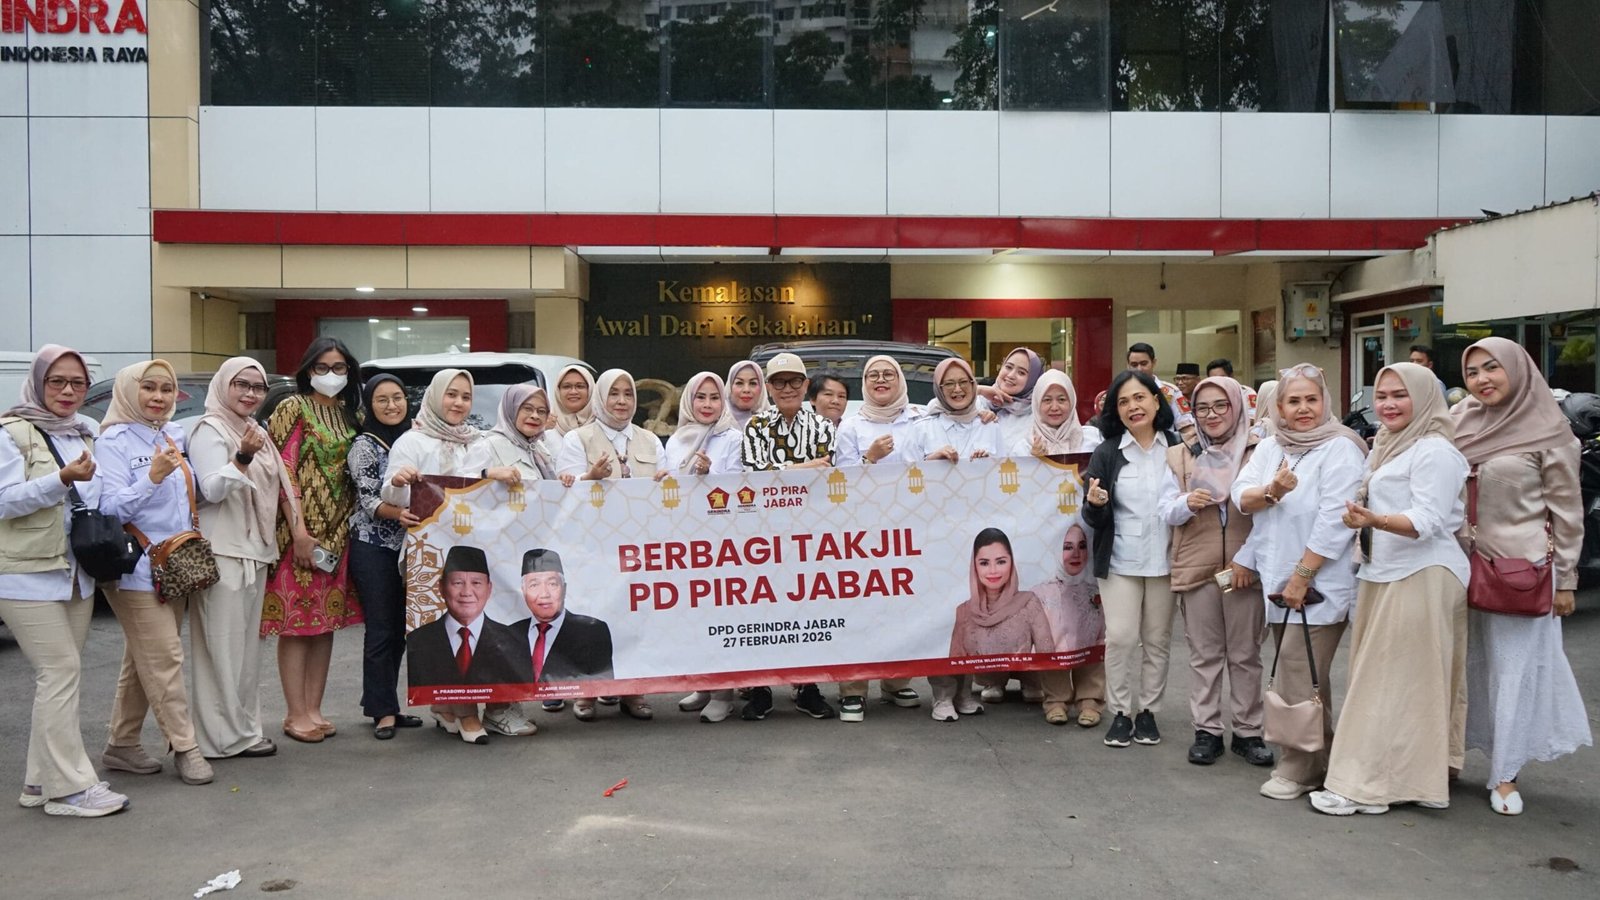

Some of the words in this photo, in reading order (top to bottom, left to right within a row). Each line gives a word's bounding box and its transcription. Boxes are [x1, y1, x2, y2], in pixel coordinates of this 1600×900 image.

[1, 46, 97, 63] INDONESIA
[103, 47, 148, 63] RAYA
[658, 280, 795, 304] Kemalasan
[659, 314, 715, 337] Dari
[763, 487, 778, 496] PD
[781, 485, 808, 495] PIRA
[763, 498, 803, 508] JABAR
[618, 536, 782, 573] BERBAGI
[791, 528, 922, 562] TAKJIL
[629, 581, 679, 612] PD
[689, 575, 777, 608] PIRA
[786, 567, 914, 602] JABAR
[708, 624, 735, 636] DPD
[737, 621, 801, 634] GERINDRA
[803, 618, 845, 630] JABAR
[722, 637, 737, 648] 27
[739, 633, 799, 647] FEBRUARI
[802, 631, 832, 643] 2026
